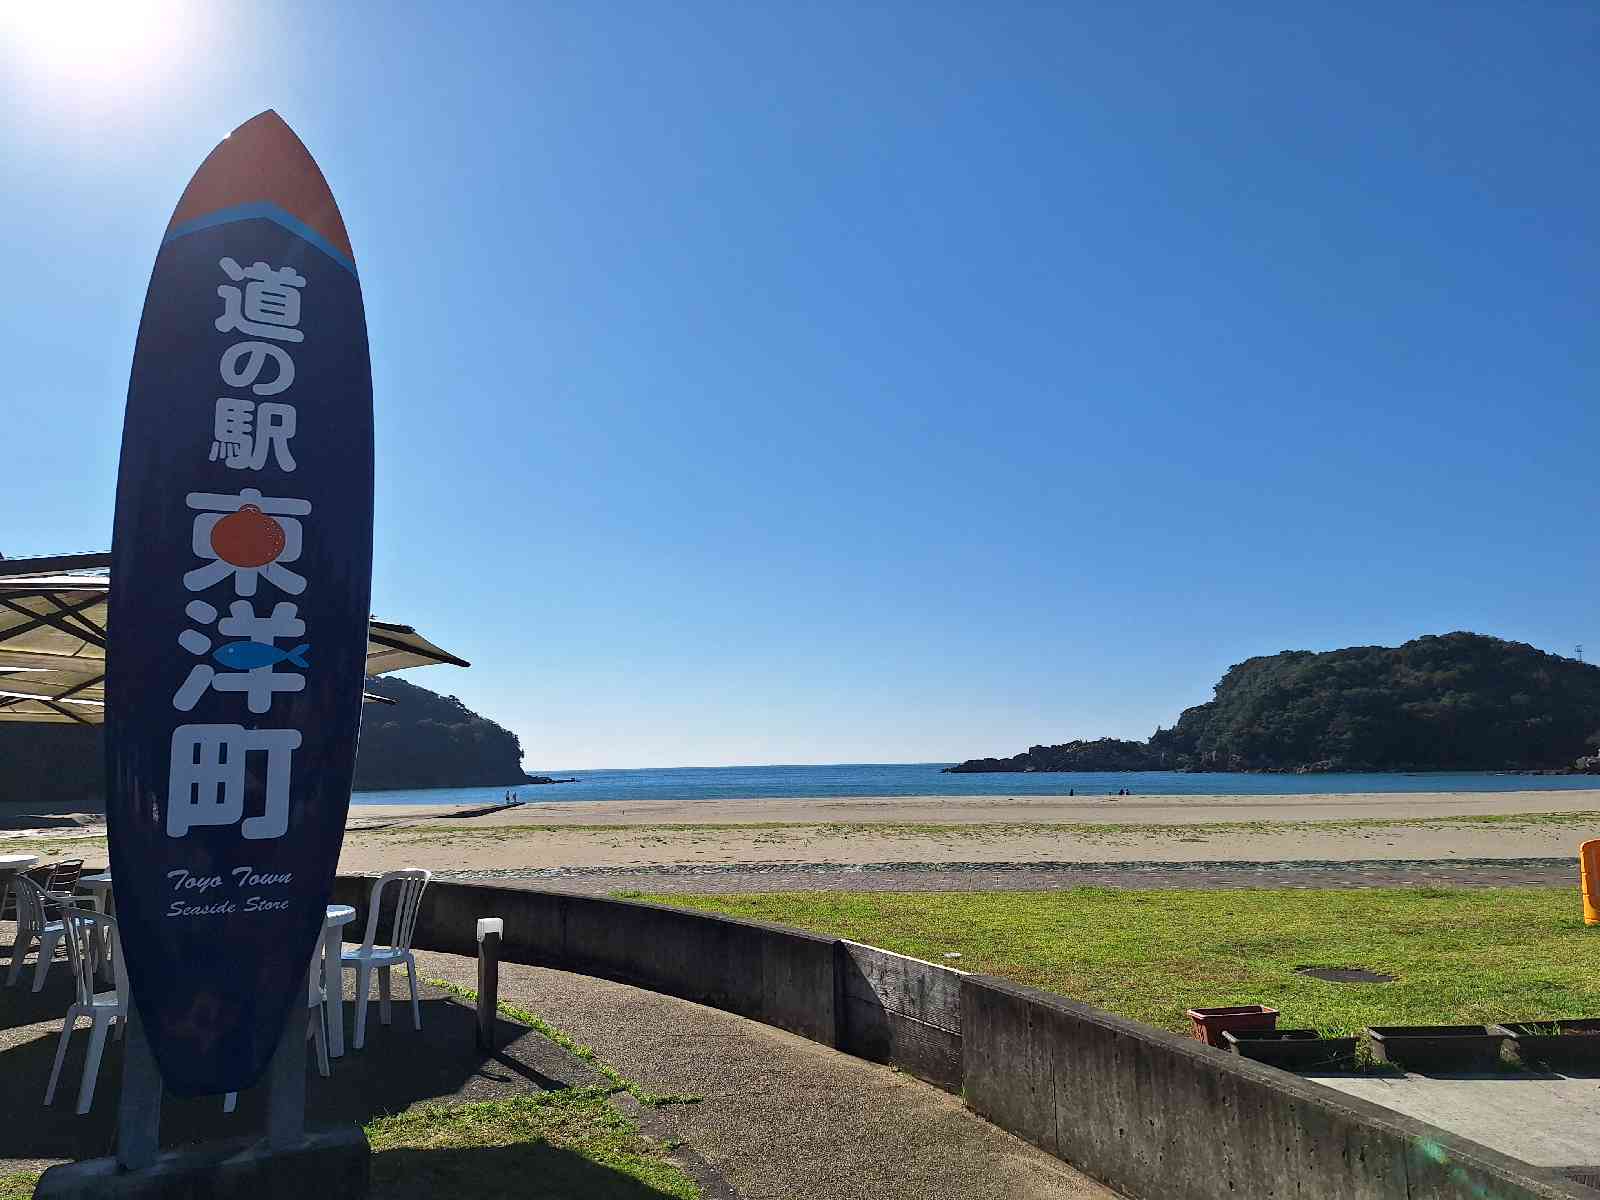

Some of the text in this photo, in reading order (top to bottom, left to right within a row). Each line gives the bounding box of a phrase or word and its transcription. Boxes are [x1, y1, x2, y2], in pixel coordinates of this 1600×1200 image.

[166, 256, 312, 839] 道の駅 東洋町
[167, 866, 293, 893] Toyo Town
[166, 896, 289, 917] Seaside Store
